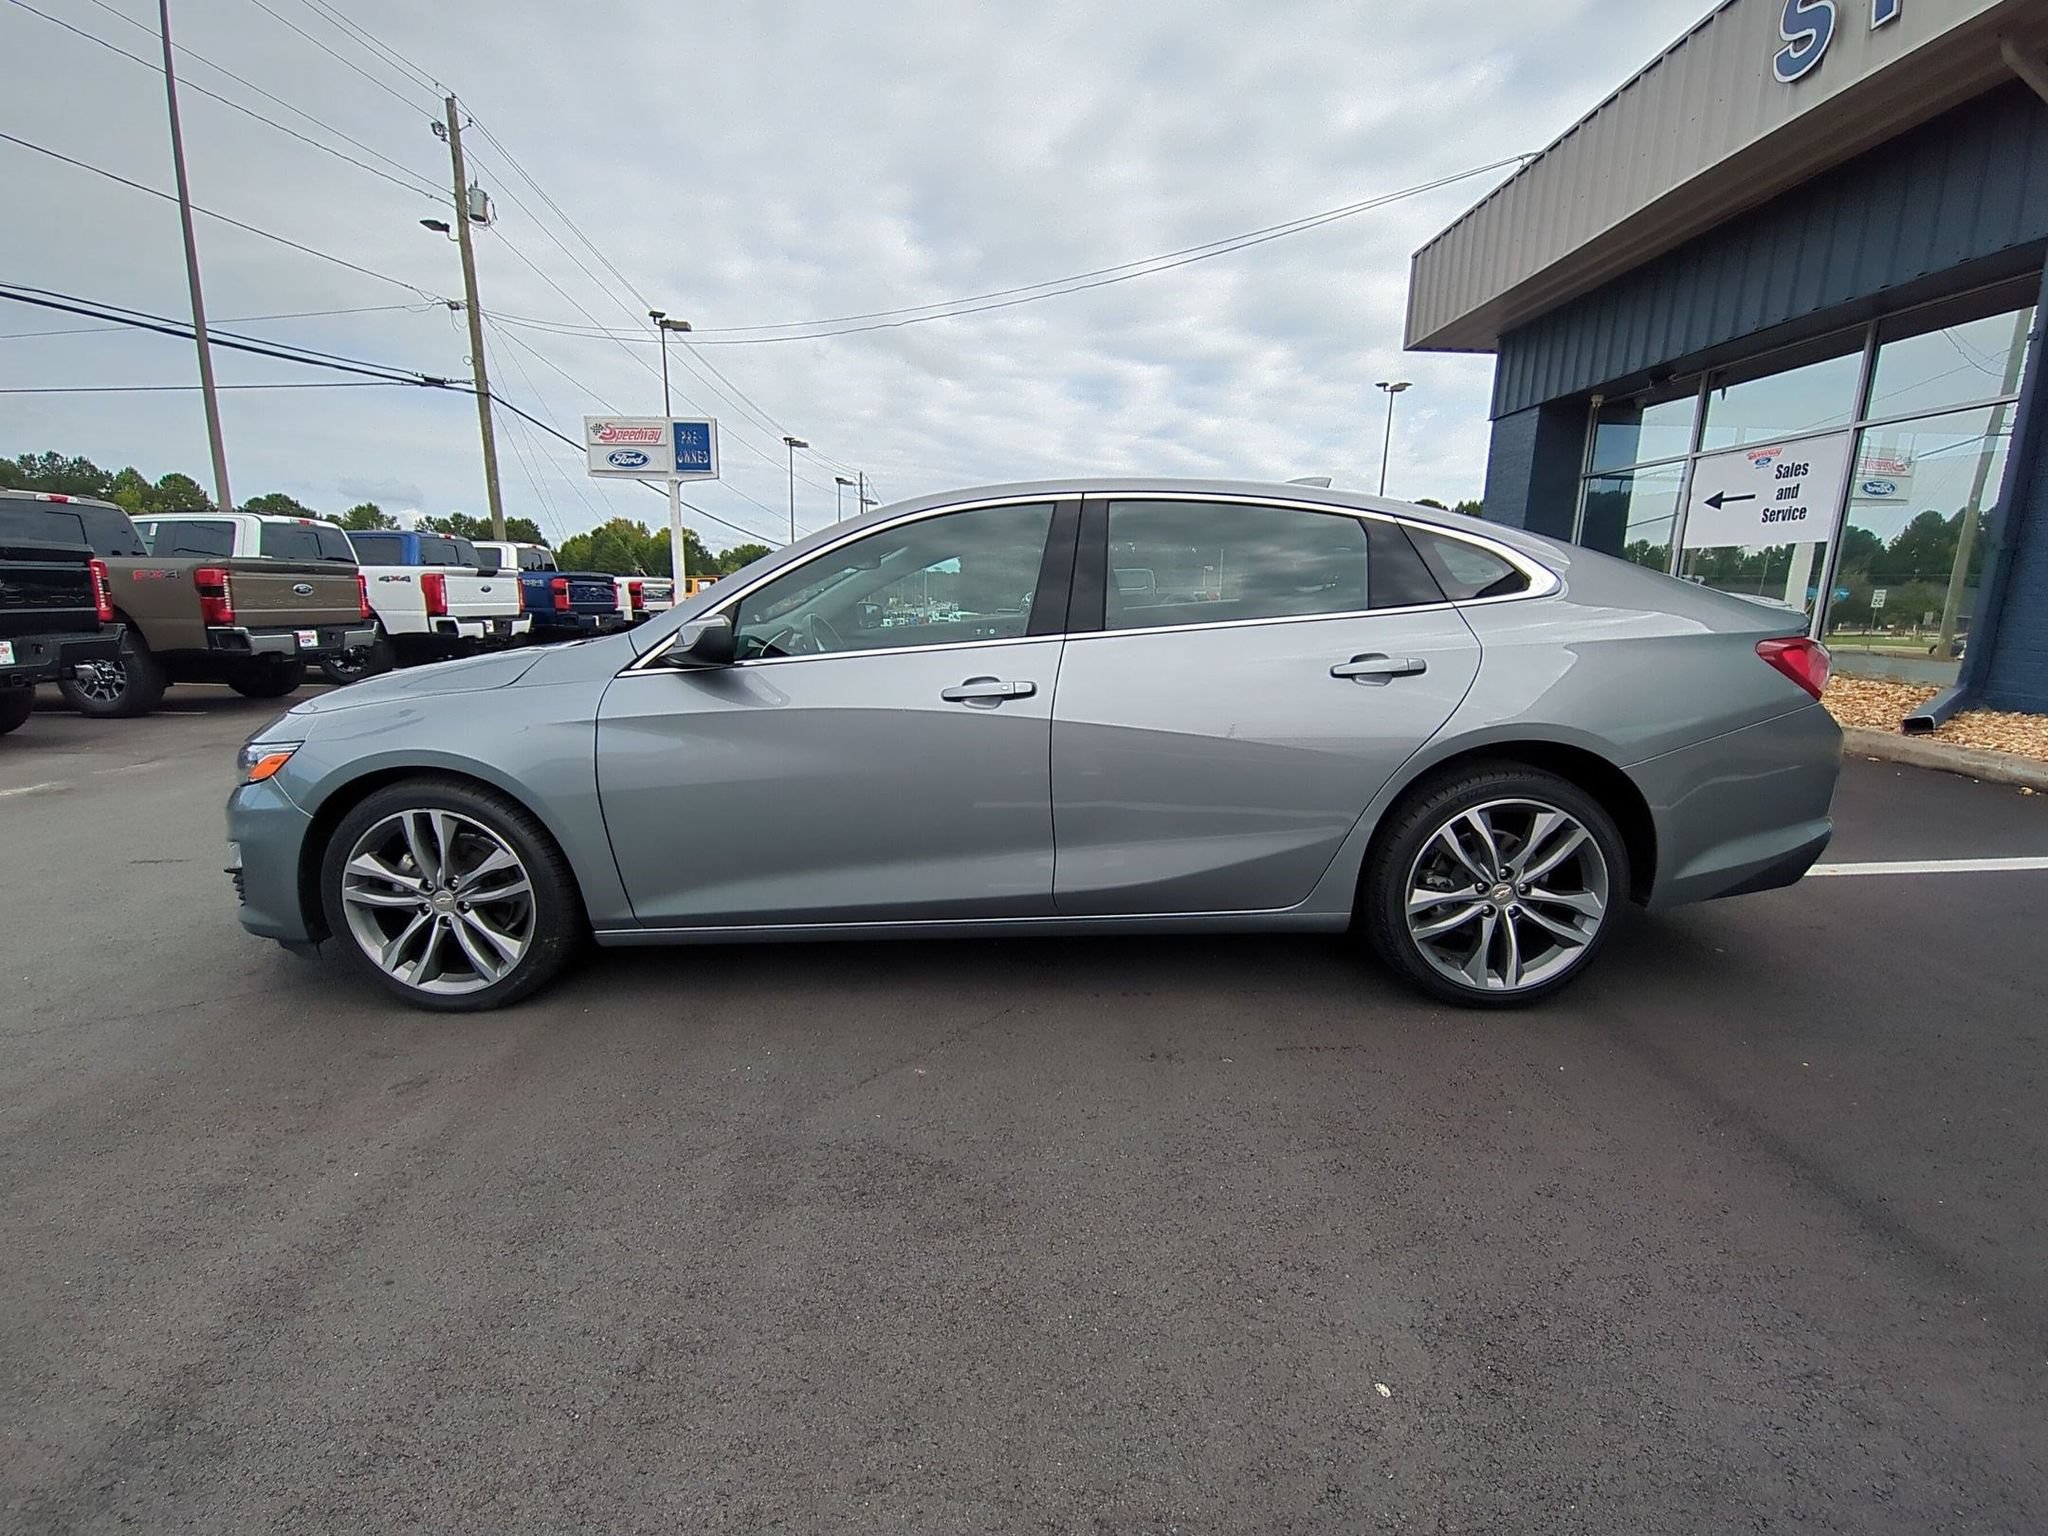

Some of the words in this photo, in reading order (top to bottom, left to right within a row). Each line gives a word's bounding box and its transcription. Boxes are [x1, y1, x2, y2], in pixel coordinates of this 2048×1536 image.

[599, 422, 663, 444] Speedway
[612, 452, 644, 465] Ford
[677, 449, 709, 464] OWNED
[1775, 462, 1810, 480] Sales
[1775, 483, 1801, 501] and
[1761, 505, 1807, 523] Service
